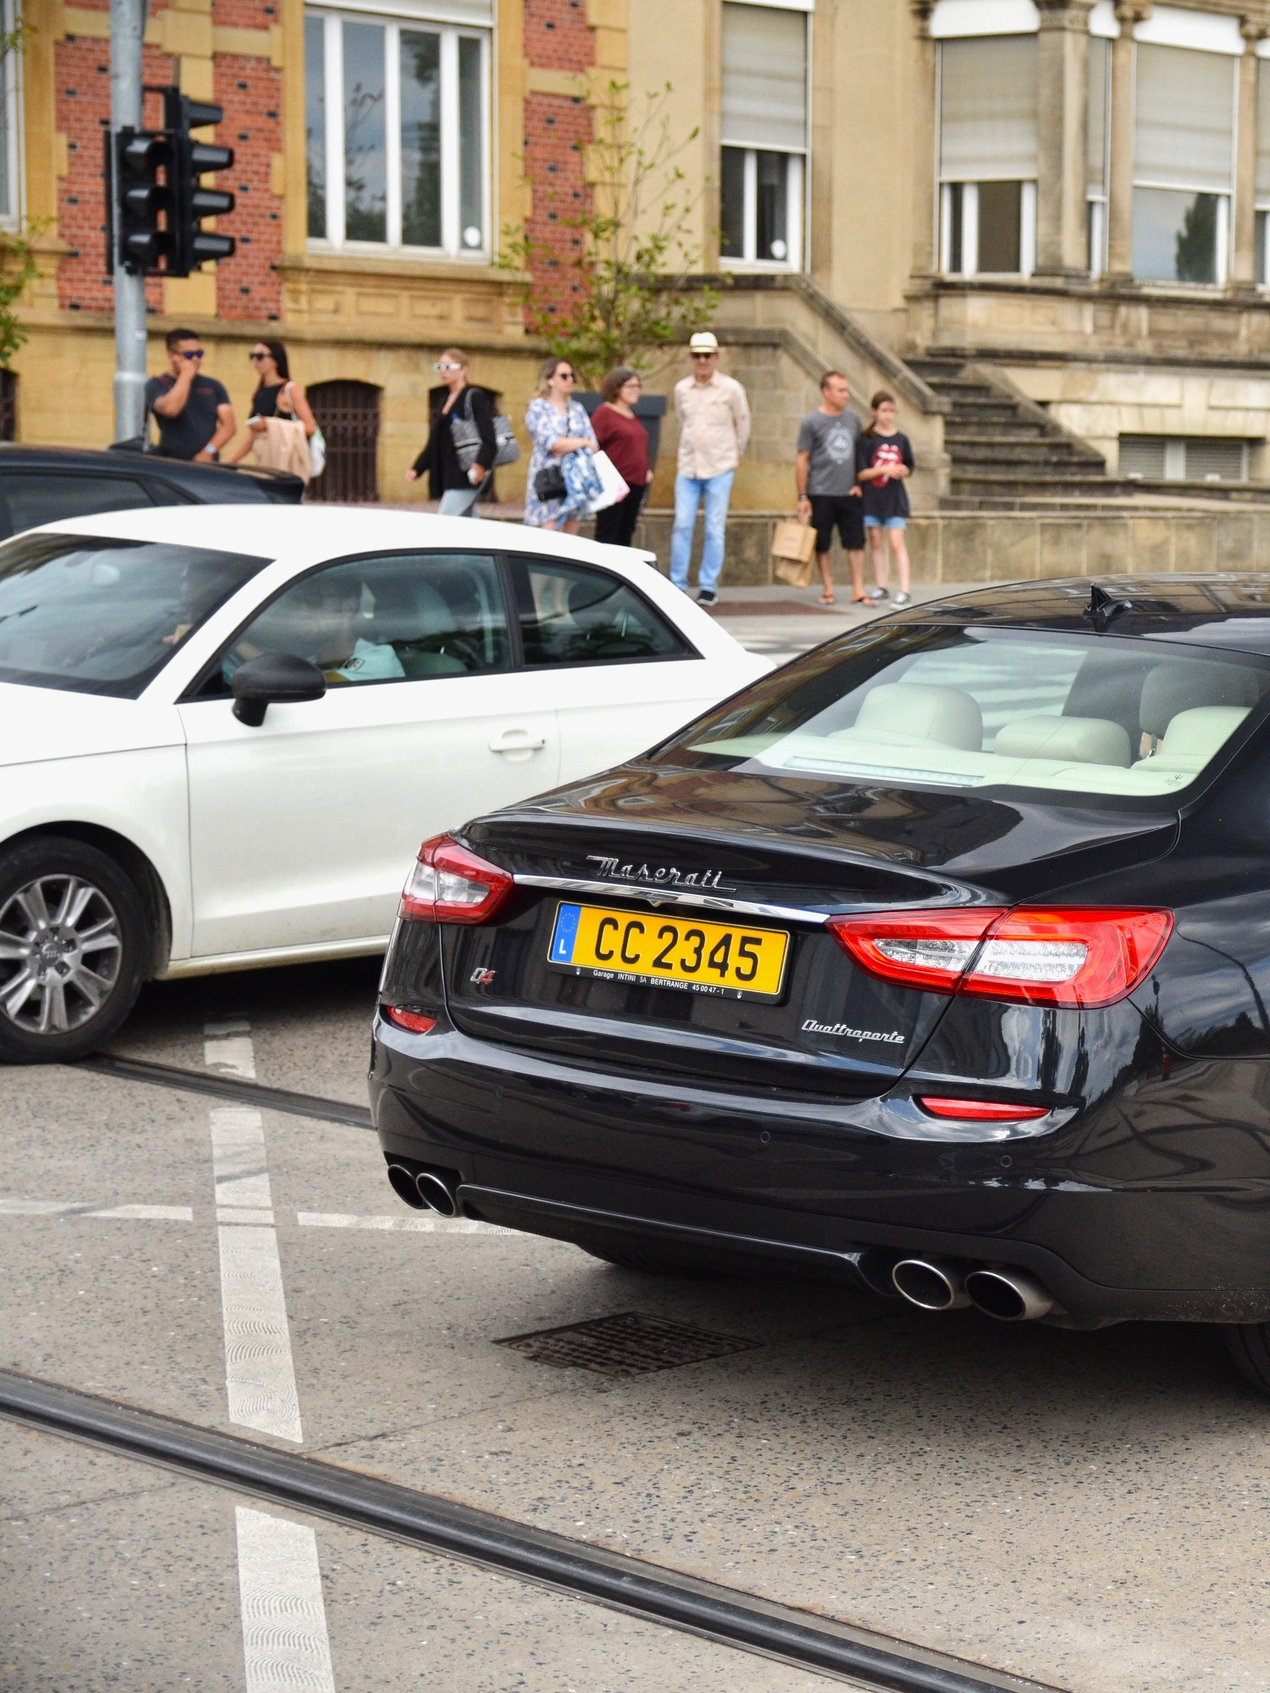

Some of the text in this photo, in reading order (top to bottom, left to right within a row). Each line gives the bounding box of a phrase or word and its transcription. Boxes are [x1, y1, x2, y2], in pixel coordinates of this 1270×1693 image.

[586, 855, 737, 893] Maserati
[558, 938, 567, 955] L
[594, 916, 763, 982] CC 2345
[470, 967, 496, 985] Q4
[593, 969, 615, 980] Garage
[617, 972, 636, 983] INTINI
[639, 976, 647, 984] SA
[650, 977, 689, 990] BERTRANGE
[801, 1019, 905, 1043] Quattroporte
